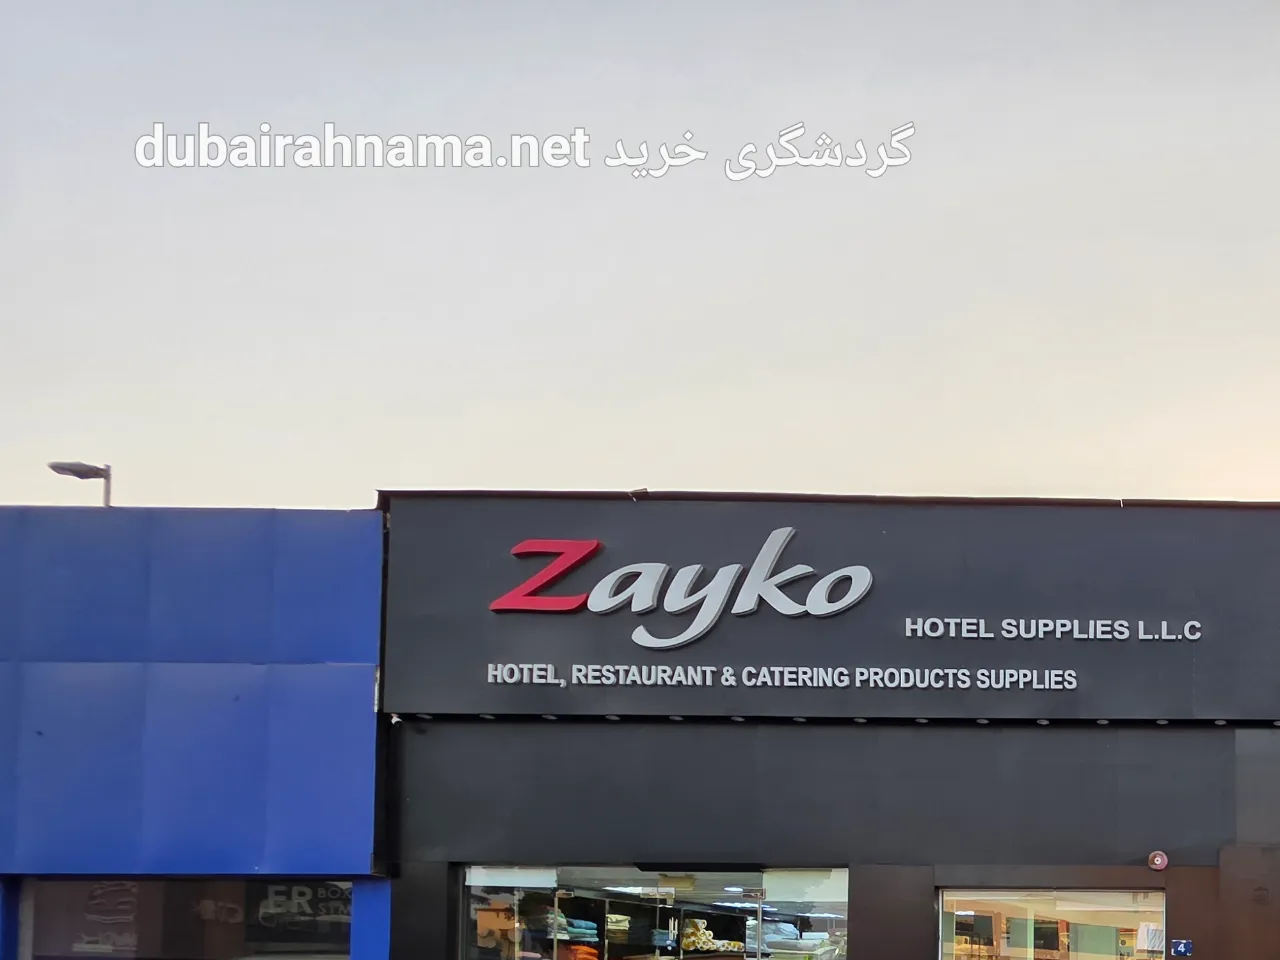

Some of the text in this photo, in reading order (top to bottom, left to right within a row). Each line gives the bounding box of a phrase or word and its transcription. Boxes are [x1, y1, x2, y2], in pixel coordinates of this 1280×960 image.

[489, 526, 873, 649] Zayko
[905, 617, 1202, 641] HOTEL SUPPLIES L.L.C
[487, 663, 1078, 691] HOTEL, RESTAURANT & CATERING PRODUCTS SUPPLIES
[1177, 943, 1186, 953] 4
